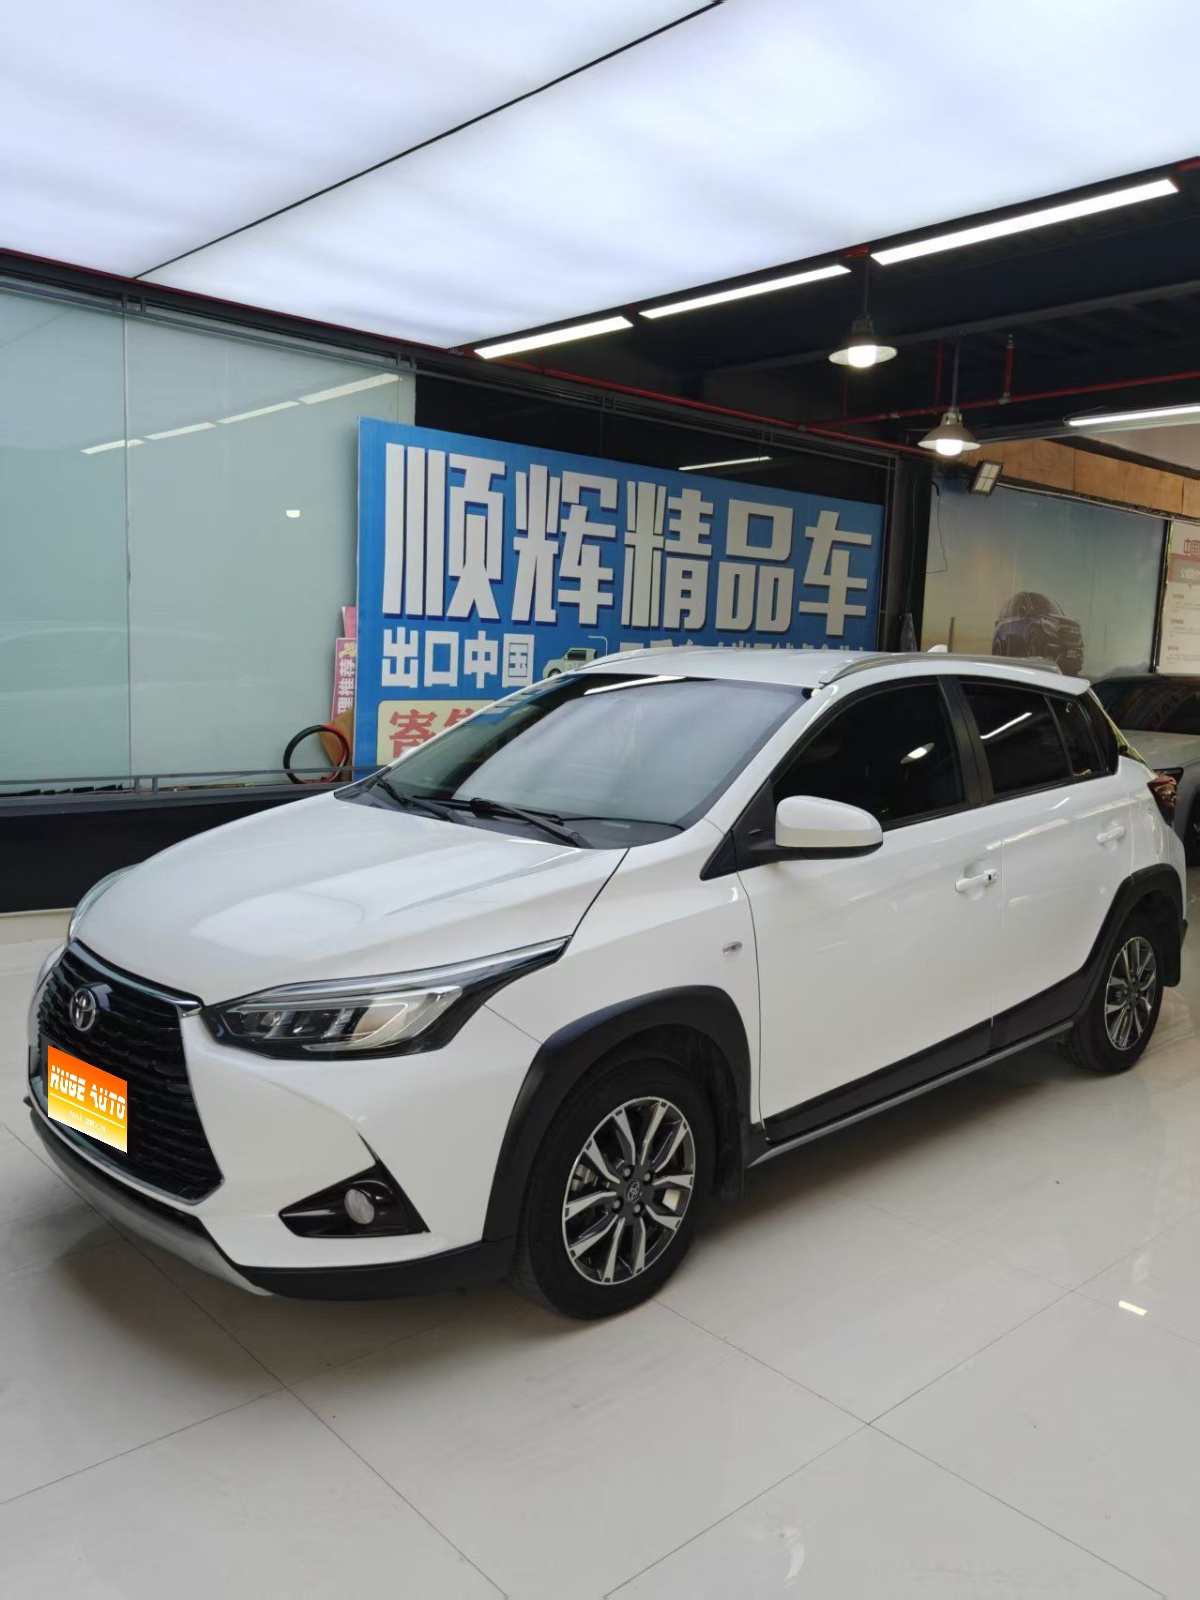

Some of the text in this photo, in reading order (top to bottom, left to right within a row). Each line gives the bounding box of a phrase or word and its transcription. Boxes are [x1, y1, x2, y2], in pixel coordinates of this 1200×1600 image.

[382, 443, 873, 636] 顺辉精品车
[381, 627, 535, 689] 出口中国
[389, 707, 476, 759] 寄
